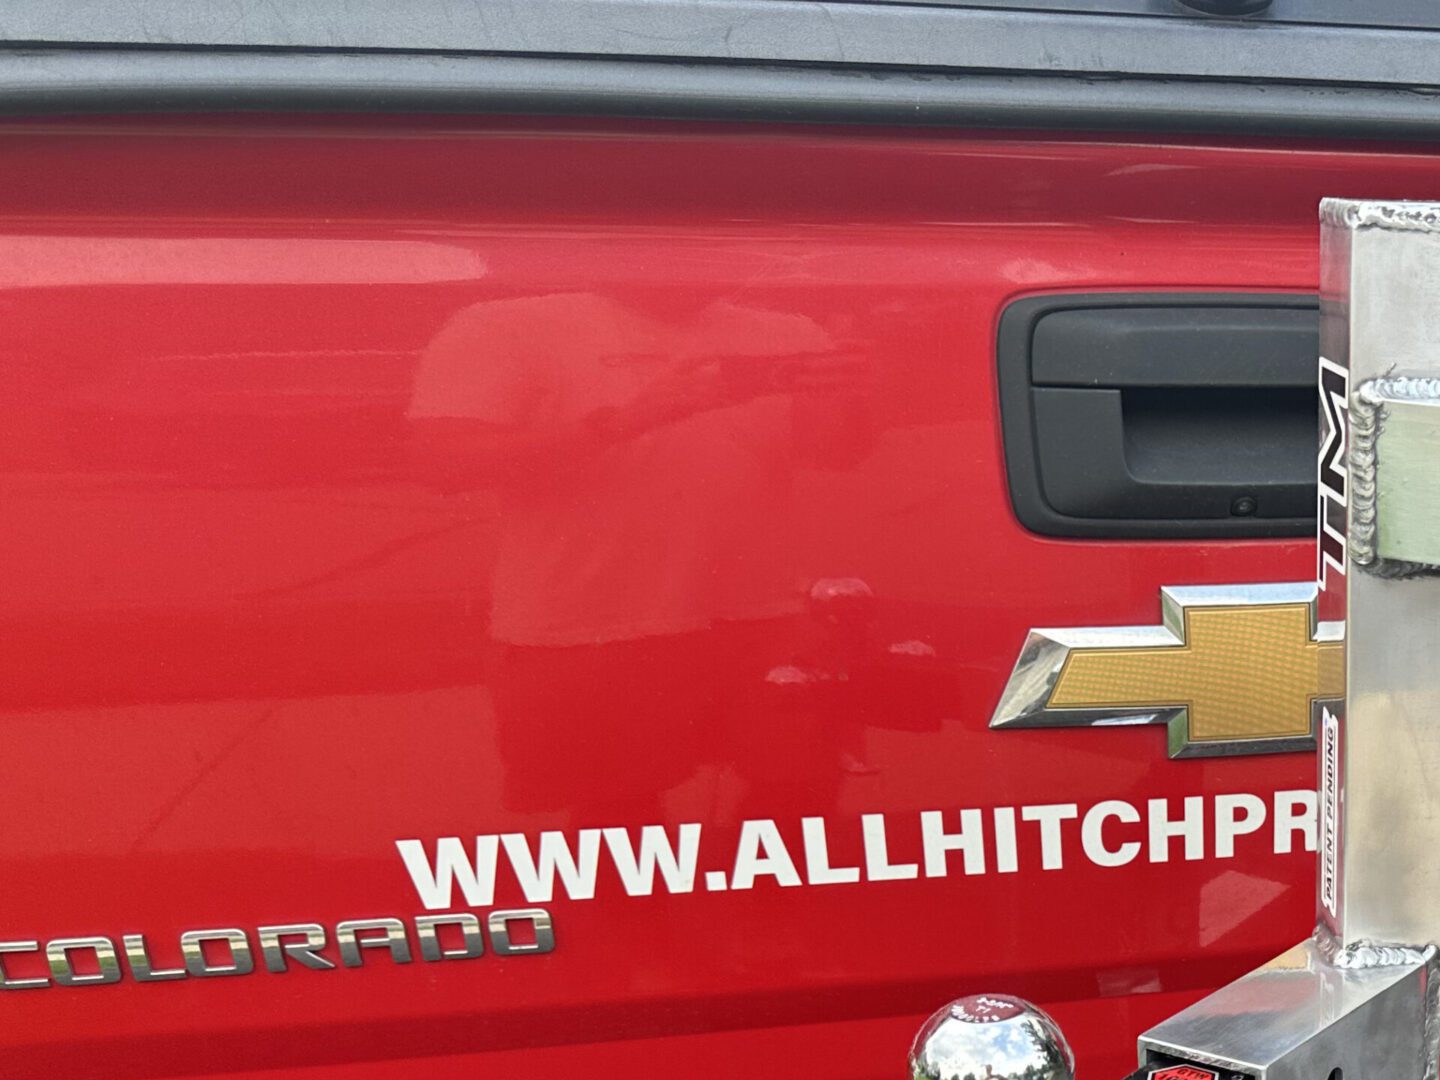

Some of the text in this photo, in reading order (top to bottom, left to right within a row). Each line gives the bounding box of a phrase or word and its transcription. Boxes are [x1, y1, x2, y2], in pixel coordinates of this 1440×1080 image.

[1325, 727, 1335, 900] PATENT PENDING
[0, 908, 556, 990] COLORADO
[1177, 1068, 1209, 1080] GTW
